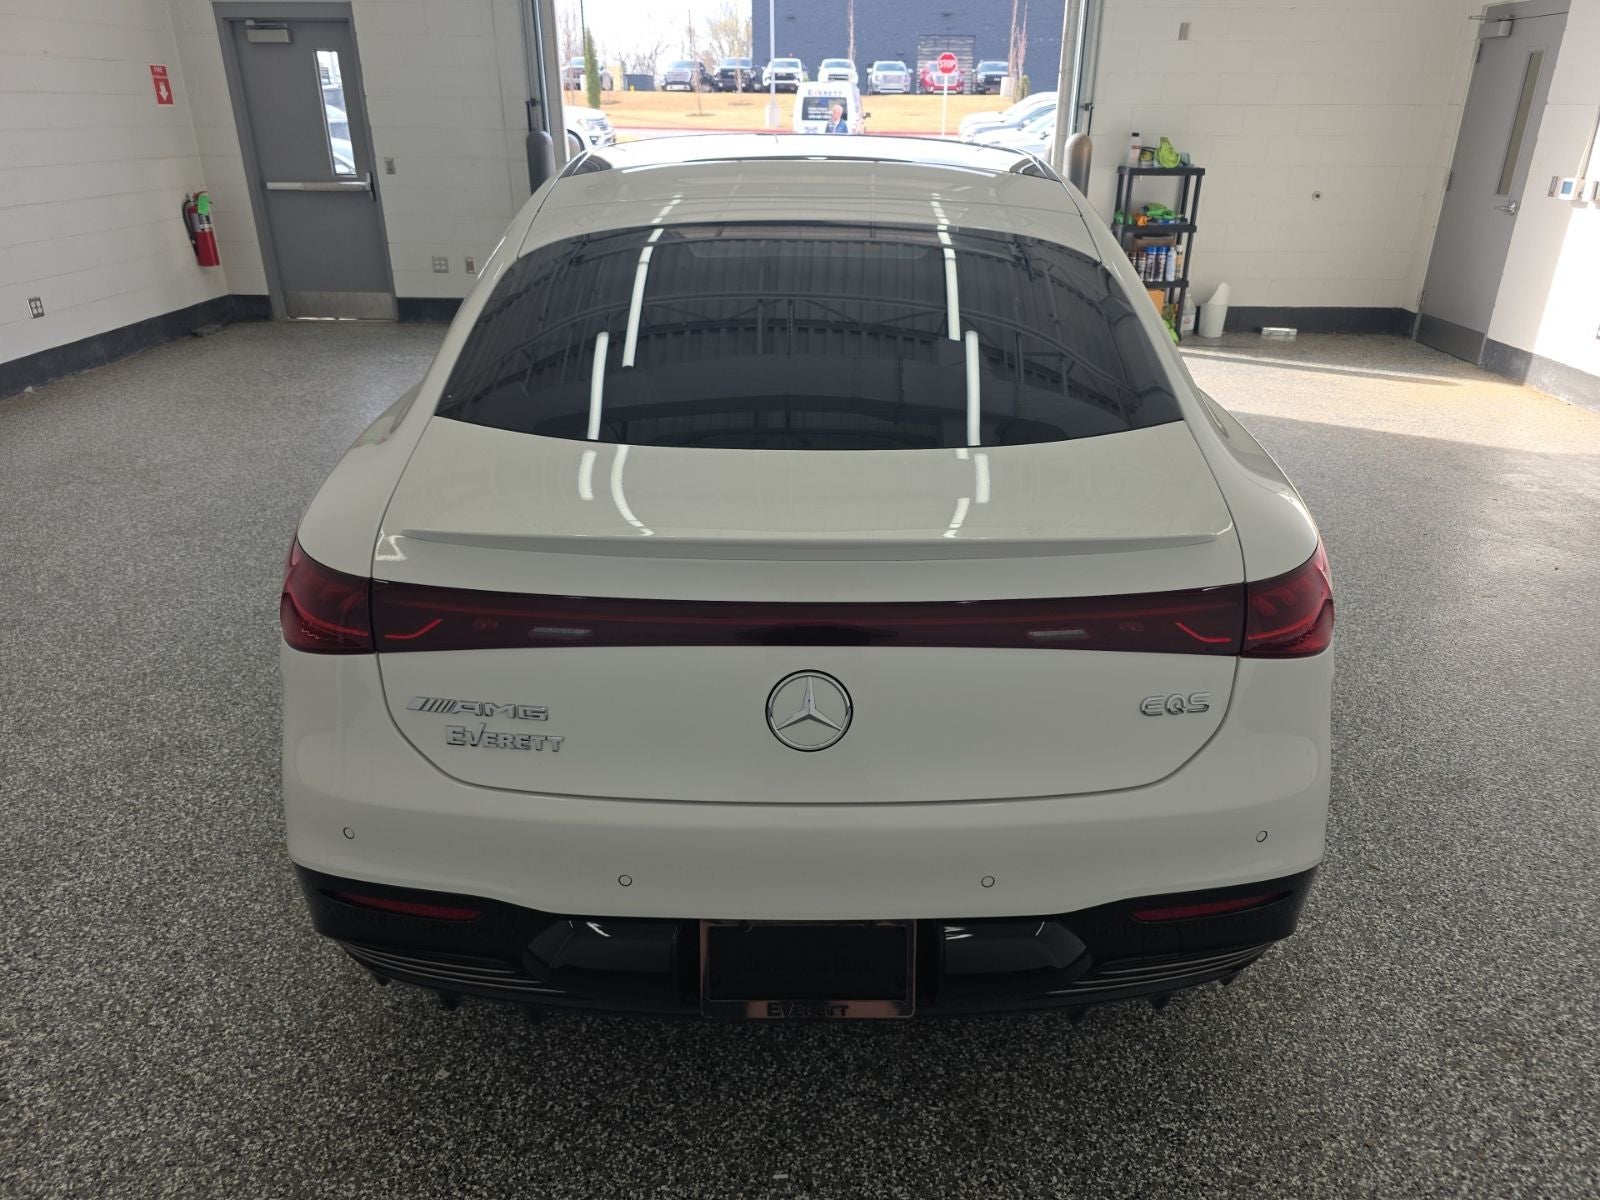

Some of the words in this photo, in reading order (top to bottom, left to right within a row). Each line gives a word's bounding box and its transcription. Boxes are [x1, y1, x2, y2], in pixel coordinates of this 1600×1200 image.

[939, 59, 957, 69] STOP
[453, 700, 548, 721] AMG
[1140, 692, 1209, 716] EQS
[446, 722, 564, 752] EVERETT
[767, 1002, 850, 1016] EVERETT
